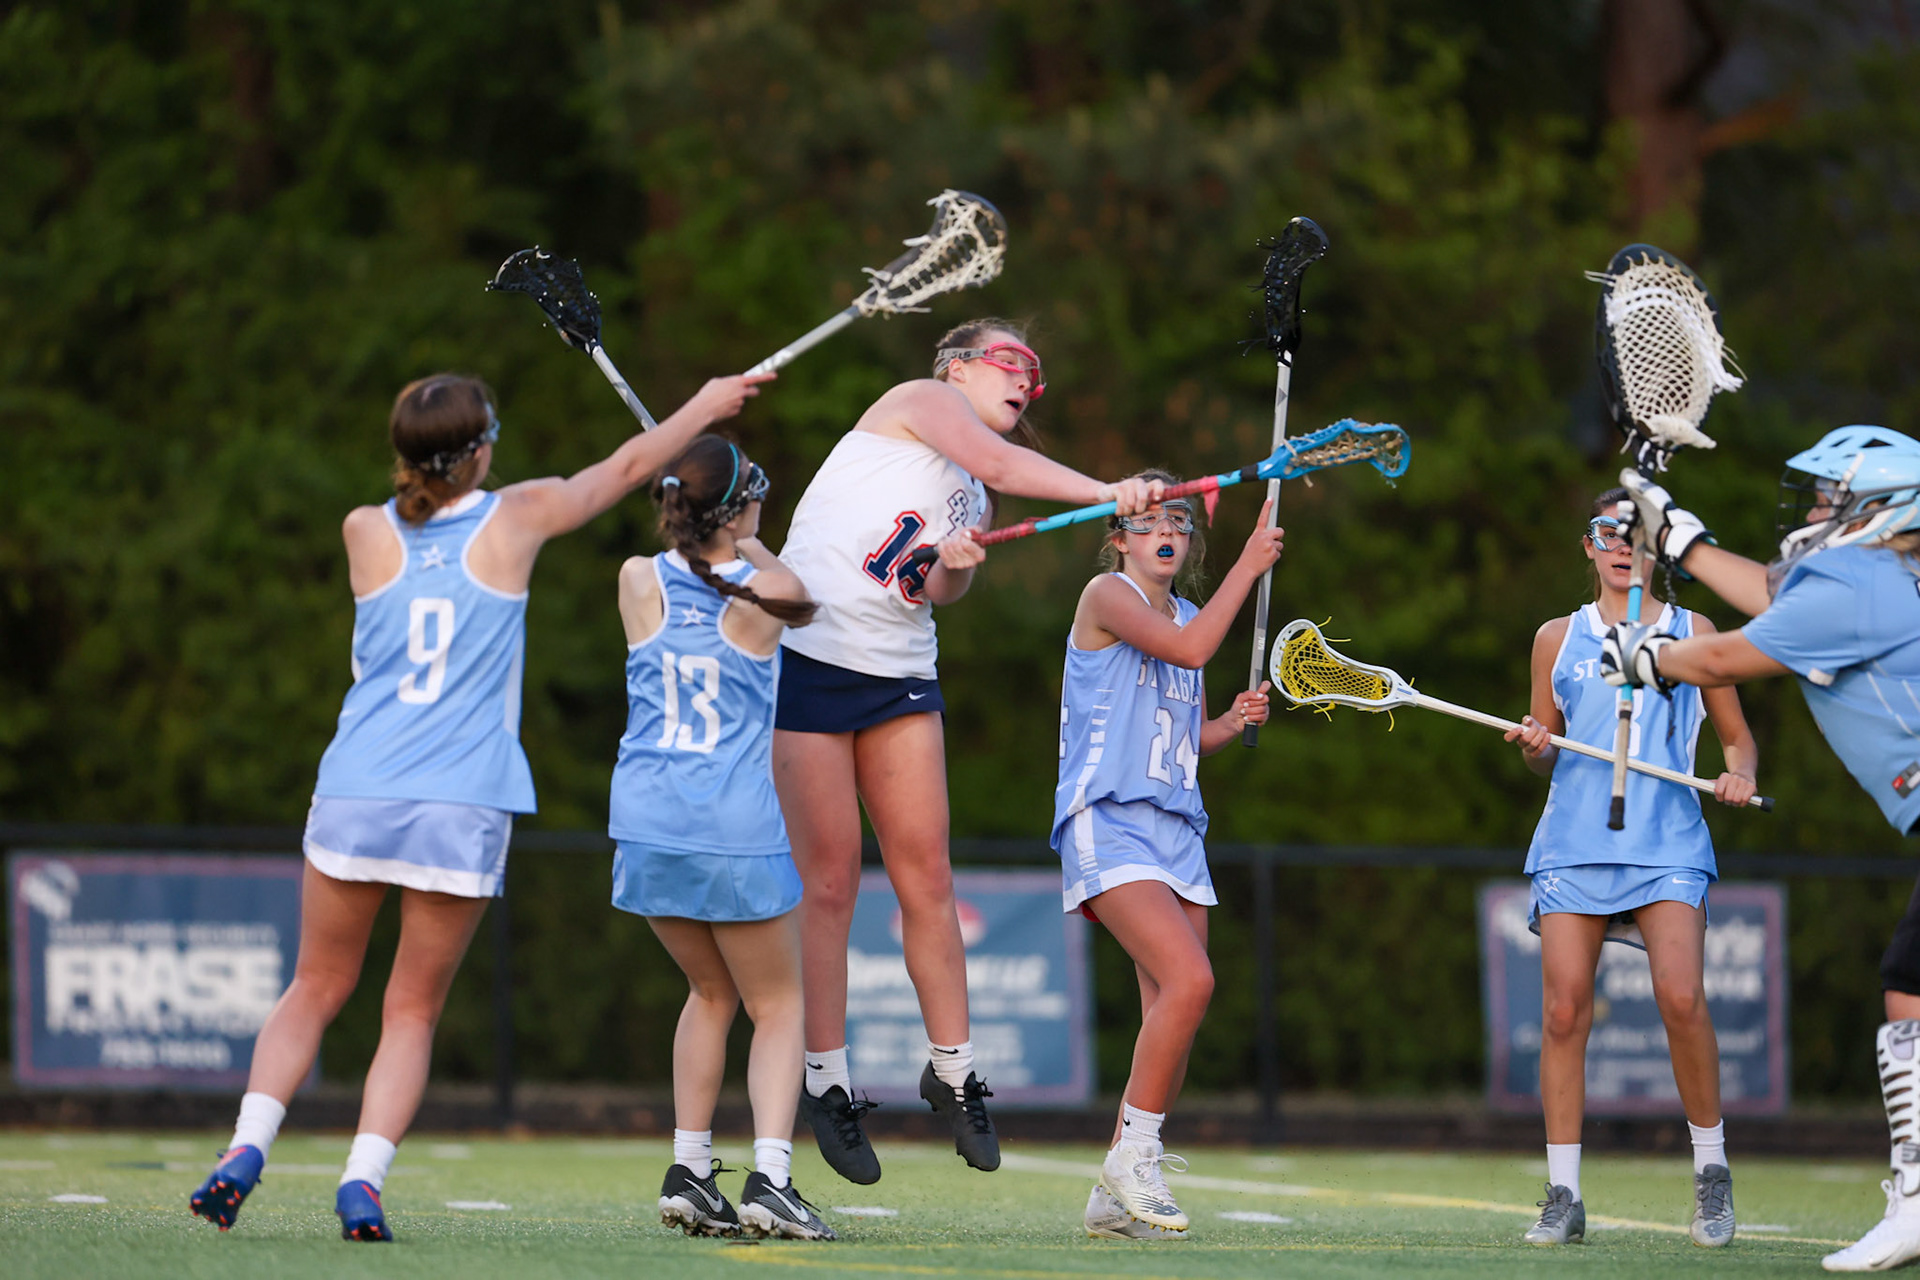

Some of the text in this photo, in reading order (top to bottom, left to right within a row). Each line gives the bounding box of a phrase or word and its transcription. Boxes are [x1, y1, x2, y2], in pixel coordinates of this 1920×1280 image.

[397, 597, 455, 704] 9
[656, 650, 721, 754] 13
[1146, 706, 1200, 792] 24
